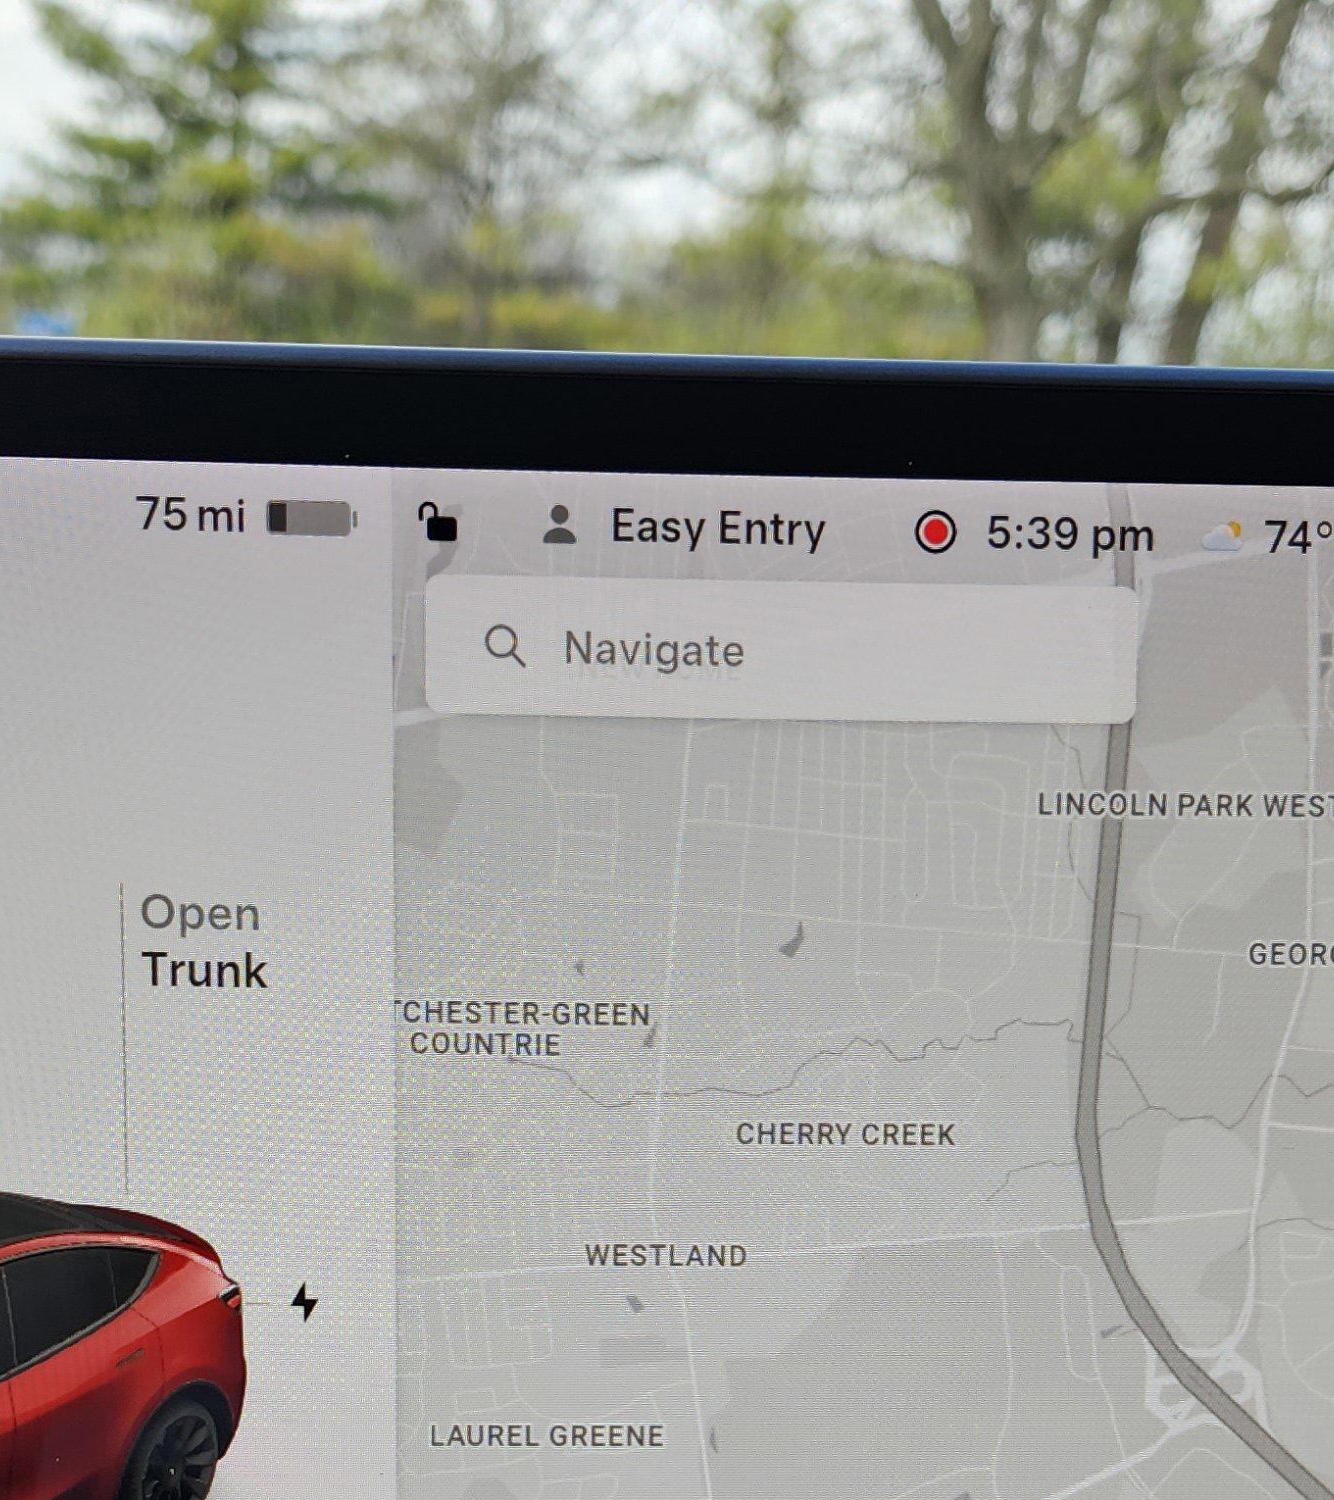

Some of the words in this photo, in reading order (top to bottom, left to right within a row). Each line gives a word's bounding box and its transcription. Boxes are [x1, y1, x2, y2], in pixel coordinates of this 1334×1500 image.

[135, 495, 187, 531] 75
[198, 498, 244, 533] mi
[613, 507, 706, 552] Easy
[719, 510, 826, 555] Entry
[988, 515, 1079, 551] 5:39
[1092, 525, 1154, 559] pm
[565, 630, 744, 675] Navigate
[1037, 791, 1167, 818] LINCOLN
[1178, 793, 1253, 818] PARK
[141, 893, 260, 938] Open
[141, 951, 268, 989] Trunk
[410, 1032, 561, 1056] COUNTRIE
[735, 1123, 851, 1146] CHERRY
[861, 1123, 956, 1146] CREEK
[584, 1243, 747, 1267] WESTLAND
[430, 1424, 540, 1447] LAUREL
[549, 1424, 665, 1447] GREENE
